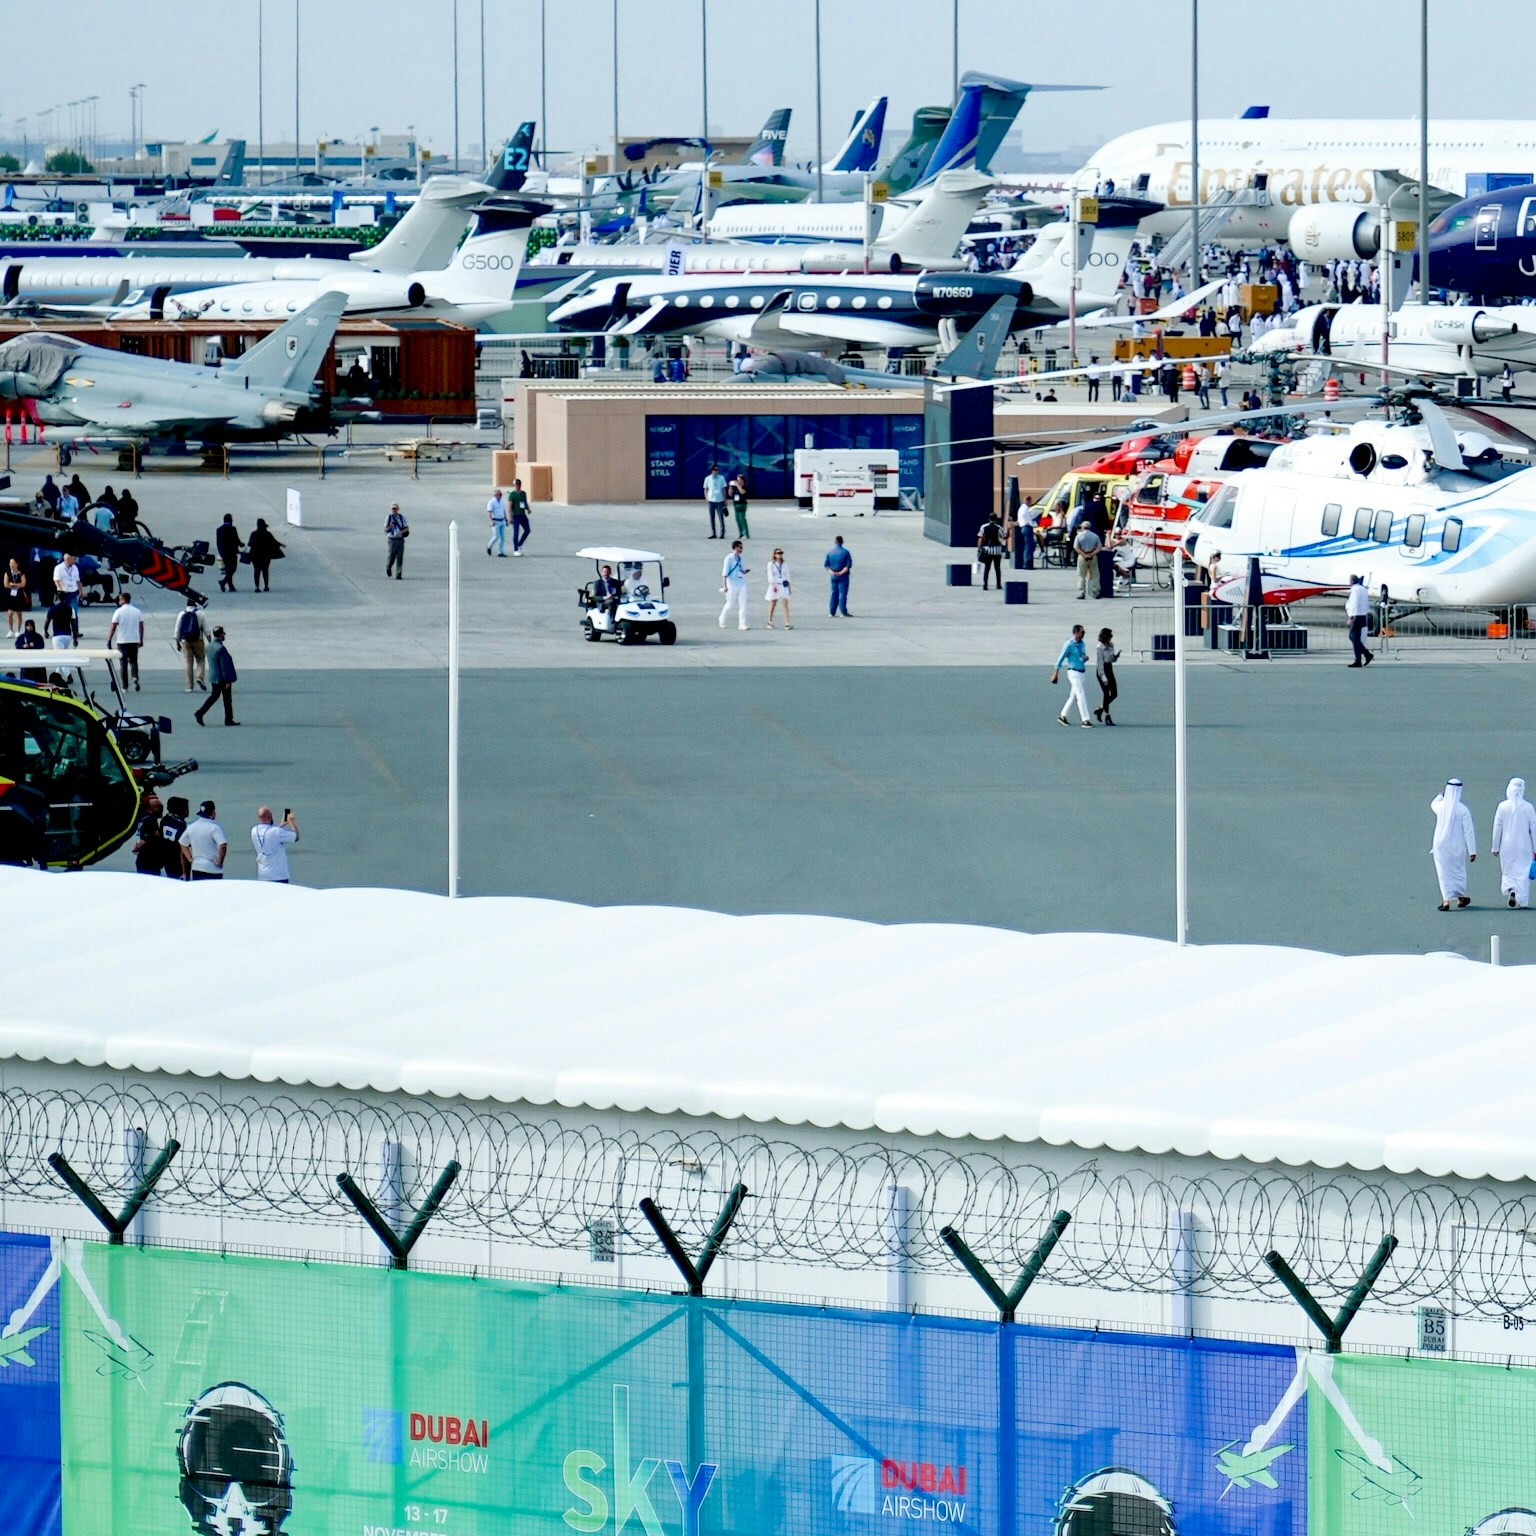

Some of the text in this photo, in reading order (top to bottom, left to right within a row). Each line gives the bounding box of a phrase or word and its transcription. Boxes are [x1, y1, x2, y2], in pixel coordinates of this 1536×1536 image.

[762, 129, 787, 140] FIVE
[504, 148, 528, 170] E2
[1167, 159, 1373, 206] Emirates
[462, 254, 514, 271] G500
[932, 286, 974, 299] N706GD
[650, 469, 671, 477] STILL
[1424, 1319, 1445, 1335] B5
[1503, 1315, 1524, 1331] B-05
[1422, 1343, 1446, 1351] POLICE
[1423, 1335, 1445, 1344] DUBAI
[410, 1413, 488, 1448] DUBAI
[409, 1448, 489, 1474] AIRSHOW
[881, 1457, 966, 1495] DUBAI
[404, 1505, 420, 1521] 13
[433, 1508, 448, 1524] 17
[881, 1495, 966, 1523] AIRSHOW
